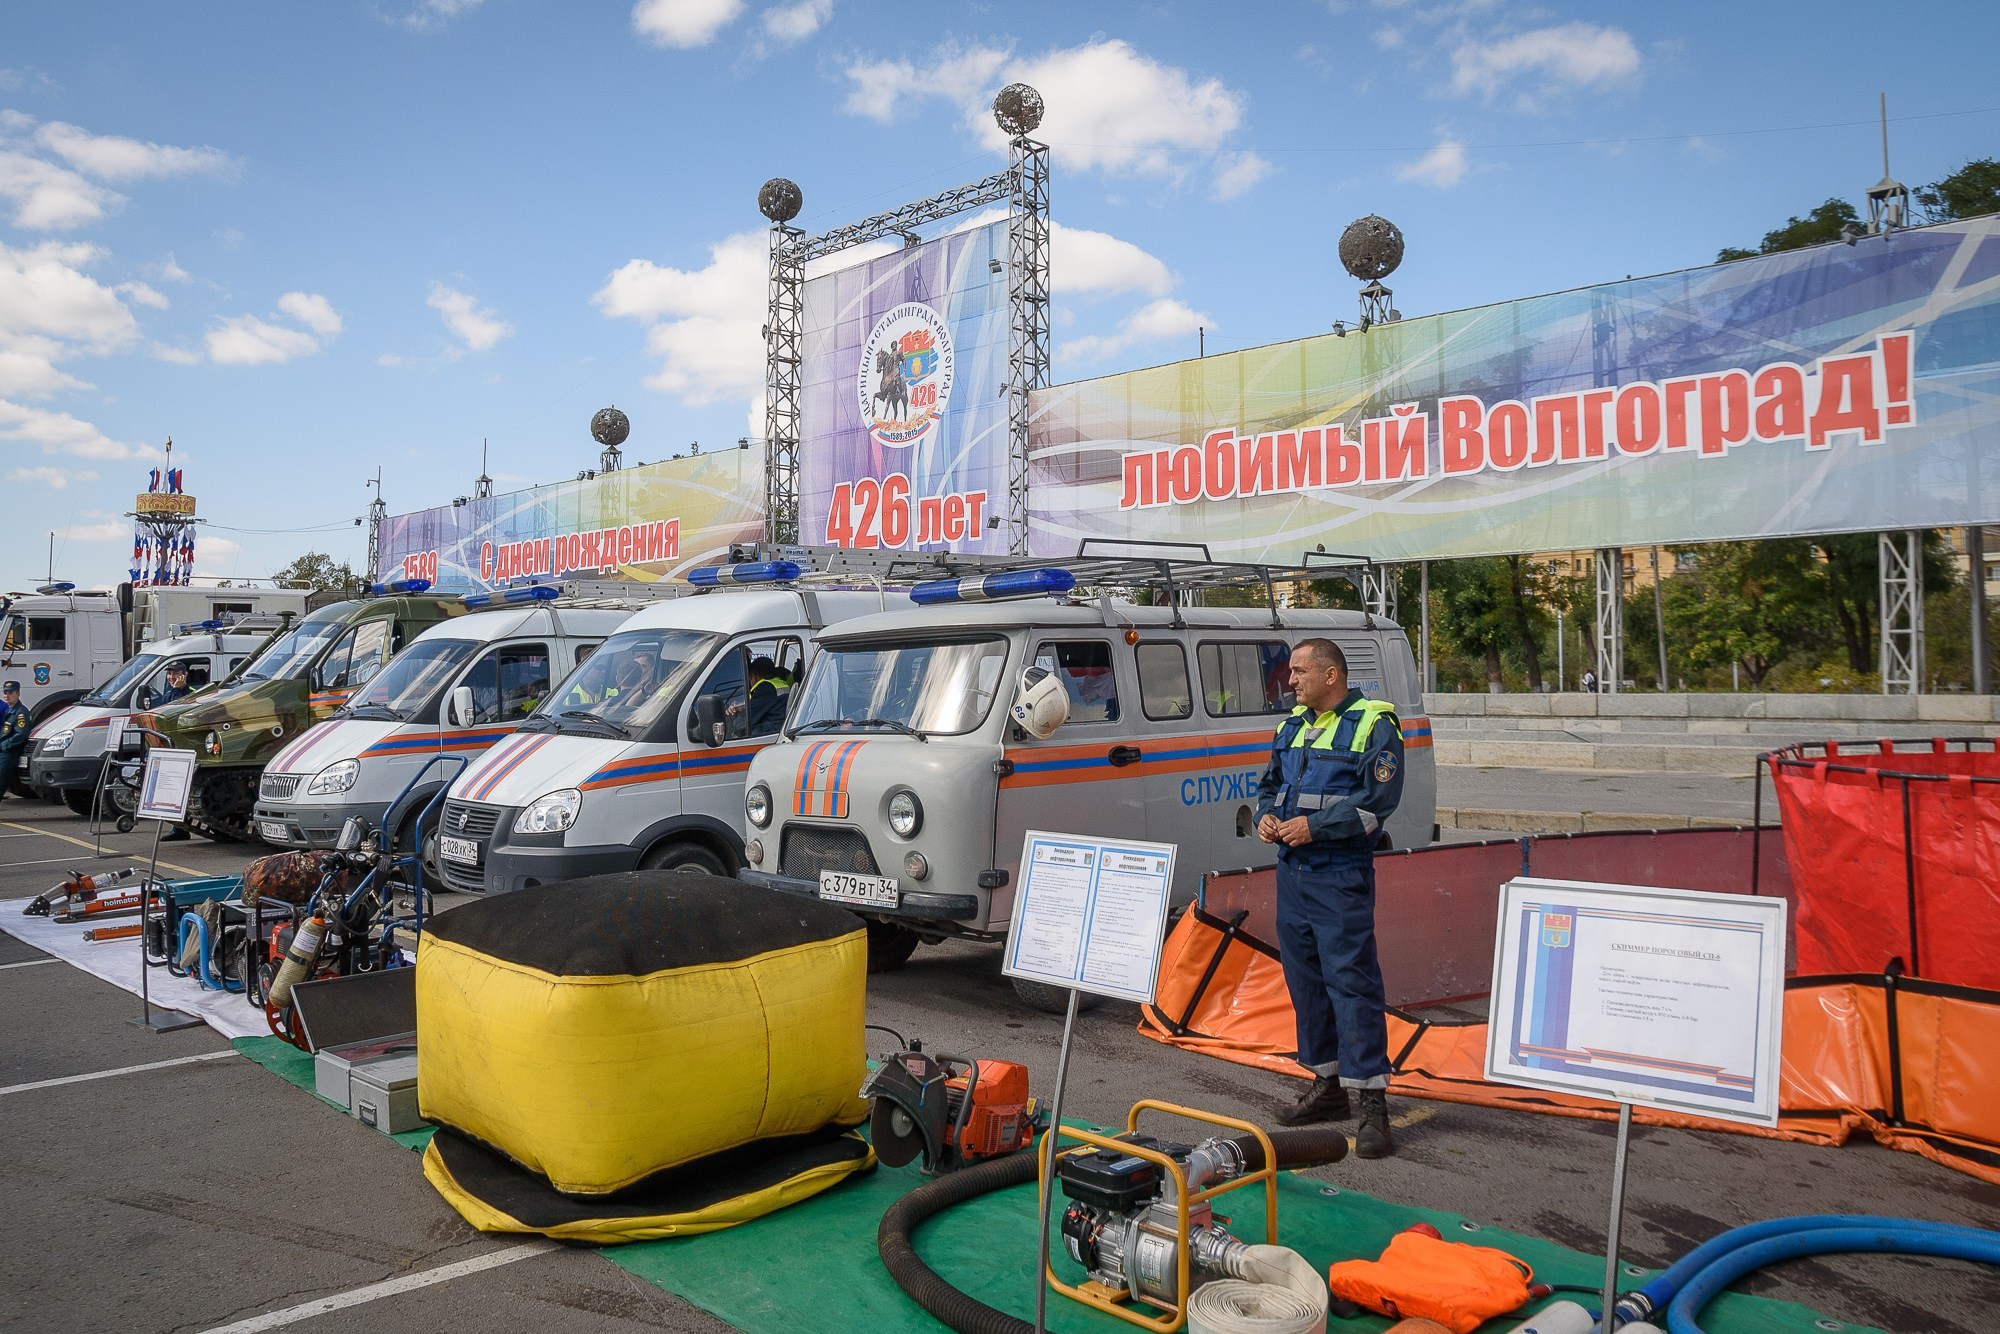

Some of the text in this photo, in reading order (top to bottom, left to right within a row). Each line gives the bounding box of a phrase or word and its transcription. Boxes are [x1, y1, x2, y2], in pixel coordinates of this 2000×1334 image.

[859, 306, 953, 417] ЦАРИЦЫН СТАЛИНГРАД ВОЛГОГРАД
[910, 384, 937, 409] 426
[1120, 334, 1913, 508] любимый Волгоград!
[826, 475, 986, 549] 426 лет
[402, 551, 437, 586] 1589
[481, 519, 680, 584] С днем рождения
[103, 896, 139, 907] holmatro
[823, 875, 893, 897] С379ВТ 34
[1651, 945, 1701, 959] ПОРОГОВЫЙ
